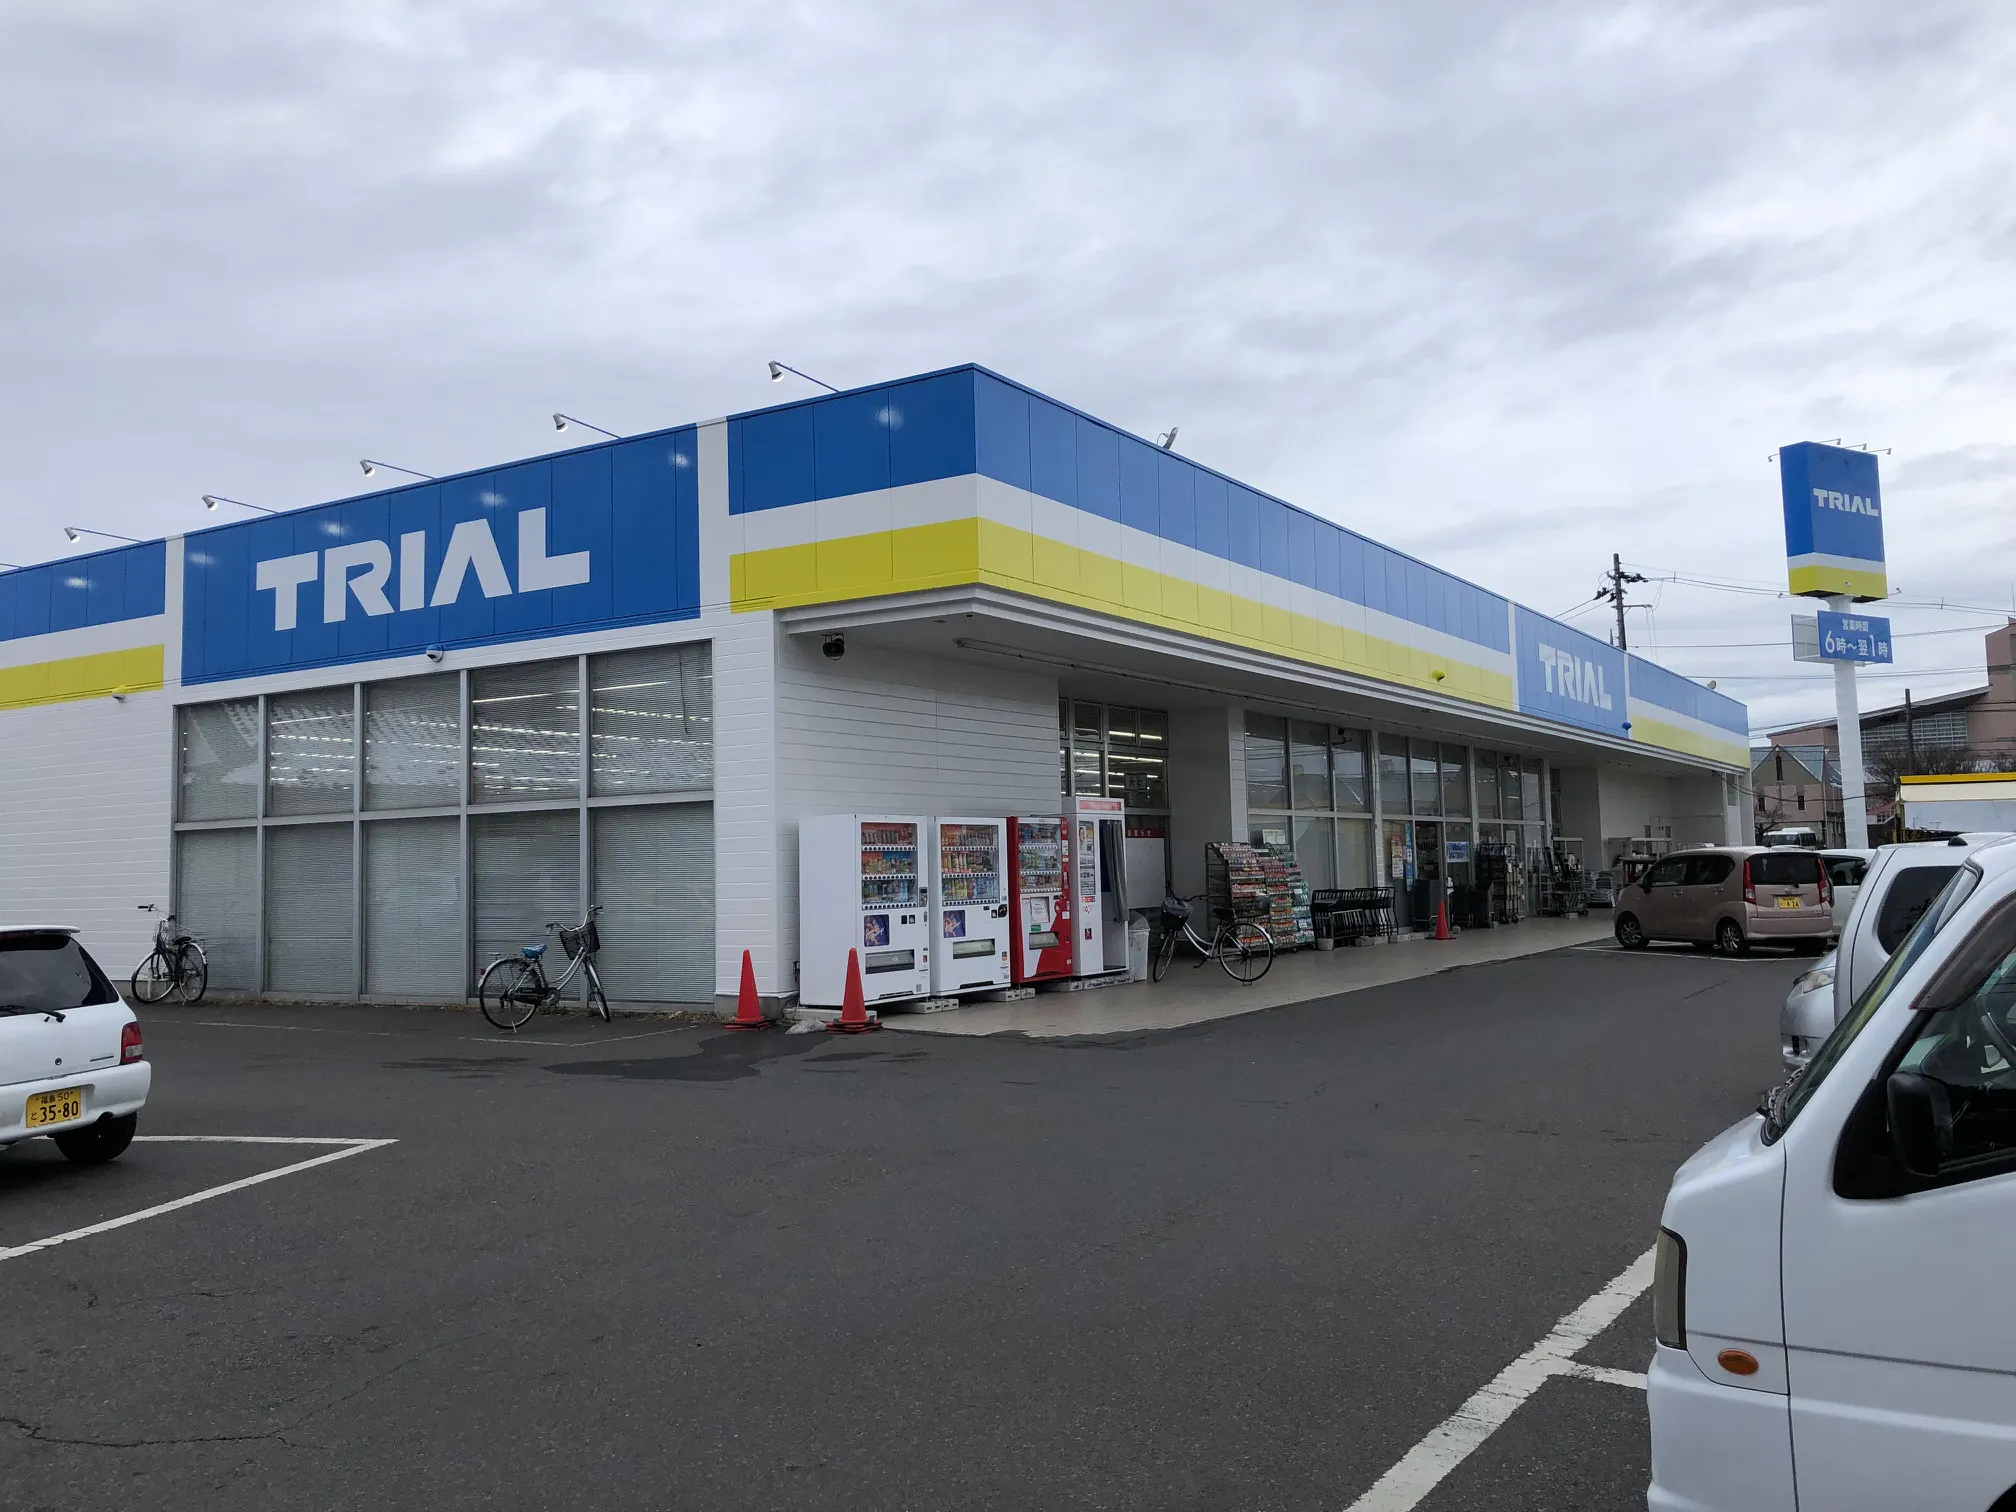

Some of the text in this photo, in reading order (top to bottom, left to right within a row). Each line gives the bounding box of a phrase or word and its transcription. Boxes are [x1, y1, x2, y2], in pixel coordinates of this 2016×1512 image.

[1813, 488, 1879, 517] TRIAL
[255, 506, 591, 632] TRIAL
[1842, 619, 1869, 632] 営業時間
[1538, 642, 1612, 711] TRIAL
